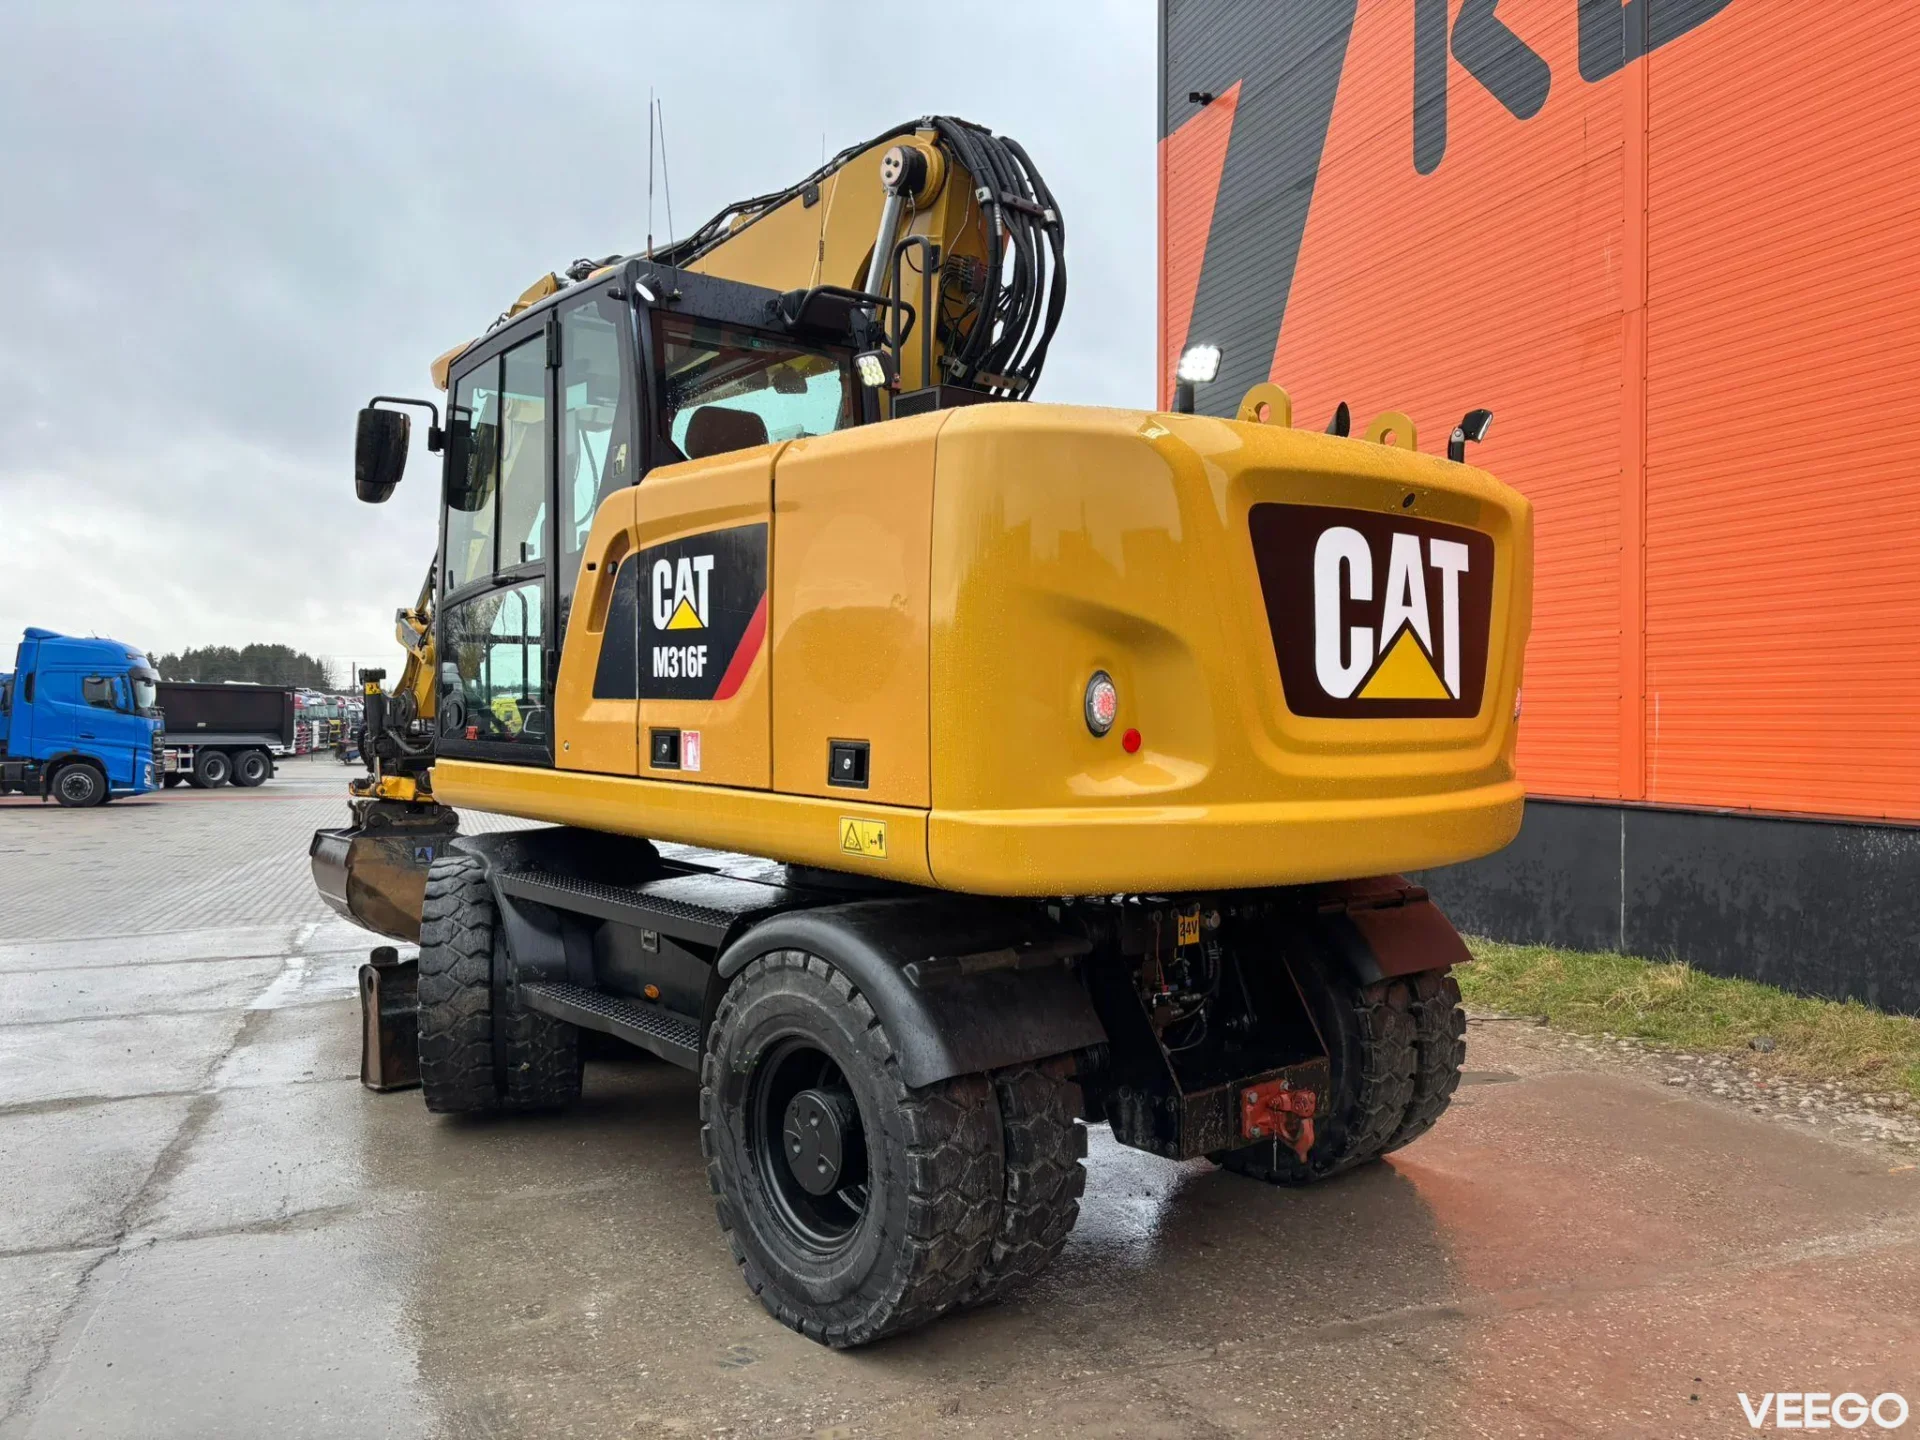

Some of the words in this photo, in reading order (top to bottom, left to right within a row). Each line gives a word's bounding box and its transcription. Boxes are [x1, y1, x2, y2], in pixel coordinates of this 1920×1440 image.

[652, 555, 714, 630] CAT
[1314, 526, 1469, 699] CAT
[653, 645, 707, 678] M316F
[1180, 919, 1198, 937] 24V
